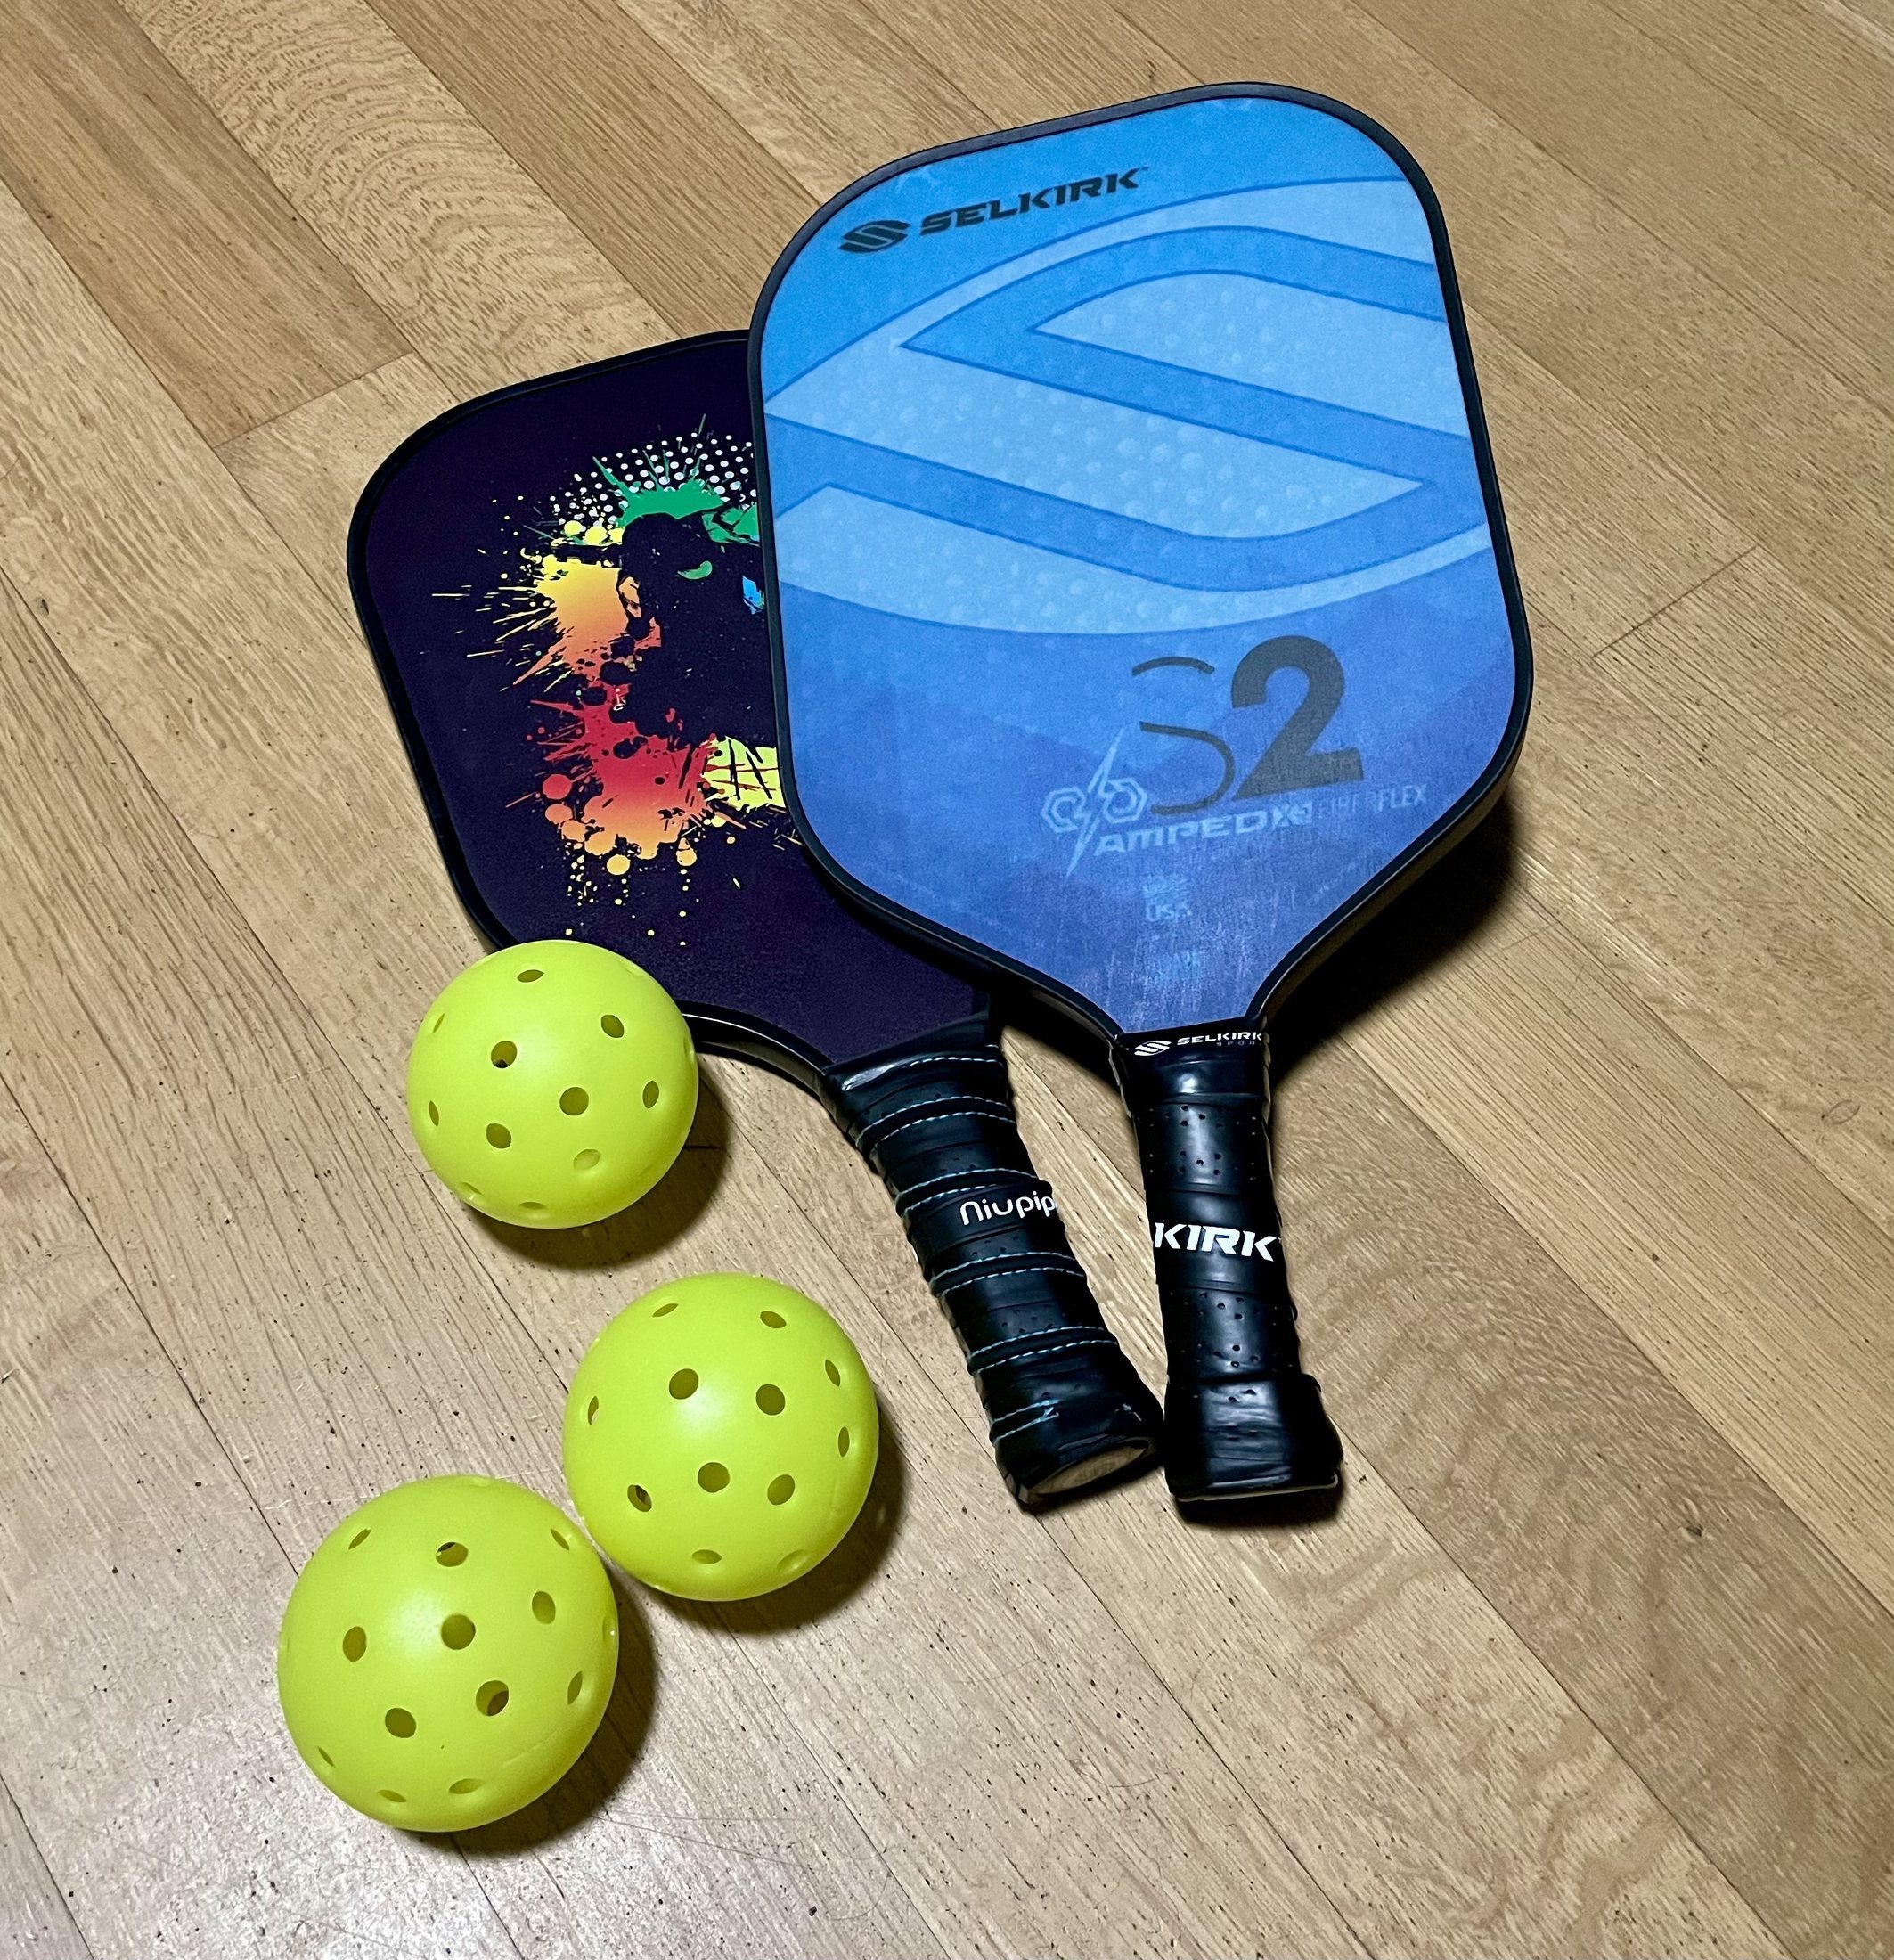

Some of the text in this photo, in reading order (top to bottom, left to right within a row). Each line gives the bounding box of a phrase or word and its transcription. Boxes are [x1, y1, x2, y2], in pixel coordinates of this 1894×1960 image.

[920, 167, 1143, 236] SELKIRK
[1131, 635, 1364, 816] S2
[1094, 807, 1268, 856] AMPED
[1177, 1032, 1262, 1046] SELKIRK
[959, 1190, 1057, 1226] Niupip
[1155, 1221, 1278, 1262] KIRK
